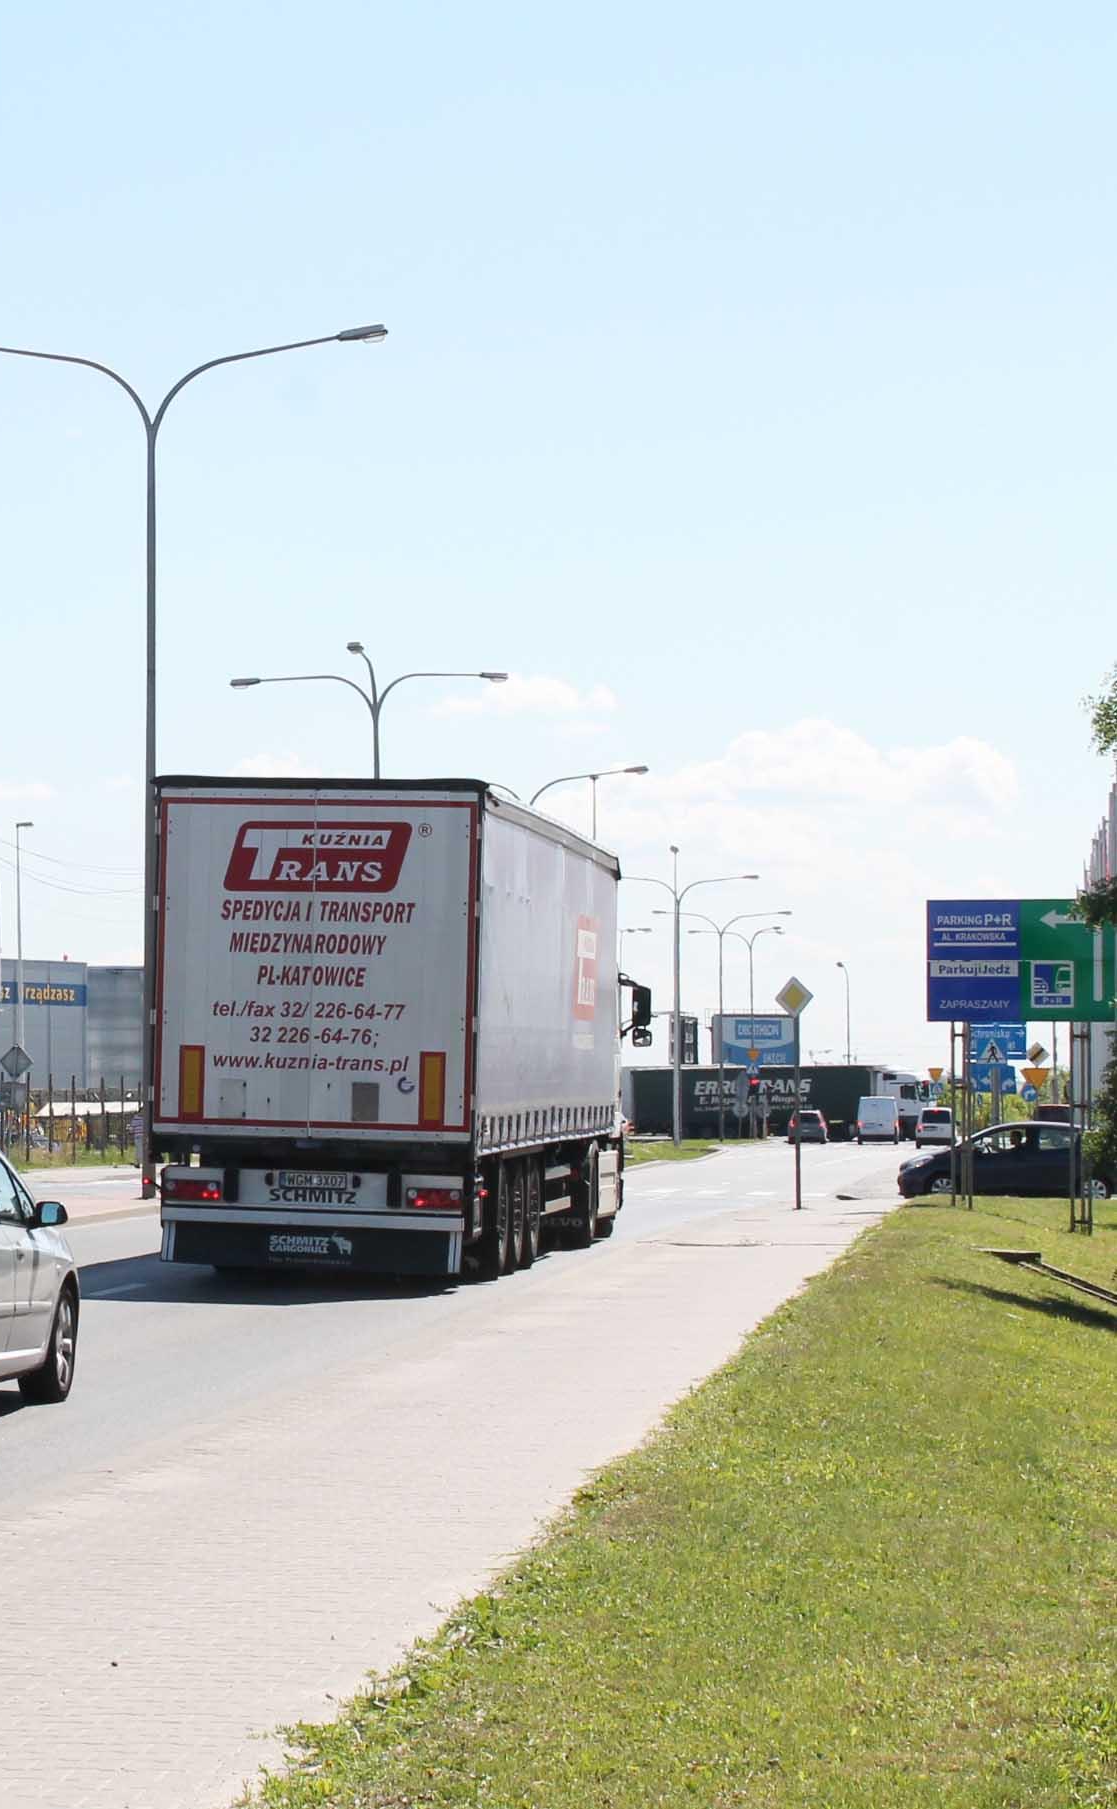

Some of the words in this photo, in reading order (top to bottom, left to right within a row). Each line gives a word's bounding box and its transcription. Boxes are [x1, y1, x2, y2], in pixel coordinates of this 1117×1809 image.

[302, 831, 385, 847] KUŹNIA
[221, 899, 301, 922] SPEDYCJA
[305, 901, 313, 922] I
[319, 901, 416, 924] TRANSPORT
[937, 914, 983, 926] PARKING
[984, 913, 1012, 926] P+R
[229, 932, 387, 956] MIĘDZYNARODOWY
[955, 932, 1006, 941] KRAKOWSKA
[256, 965, 367, 988] PL-KATOWICE
[213, 1001, 275, 1018] tel./fax
[279, 1001, 310, 1018] 32/
[314, 1002, 406, 1020] 226-64-77
[939, 999, 1011, 1009] ZAPRASZAMY
[249, 1026, 271, 1043] 32
[276, 1026, 310, 1043] 226
[213, 1052, 409, 1076] www.kuznia-trans.pl
[269, 1188, 357, 1205] SCHMITZ
[269, 1235, 331, 1246] SCHMITZ
